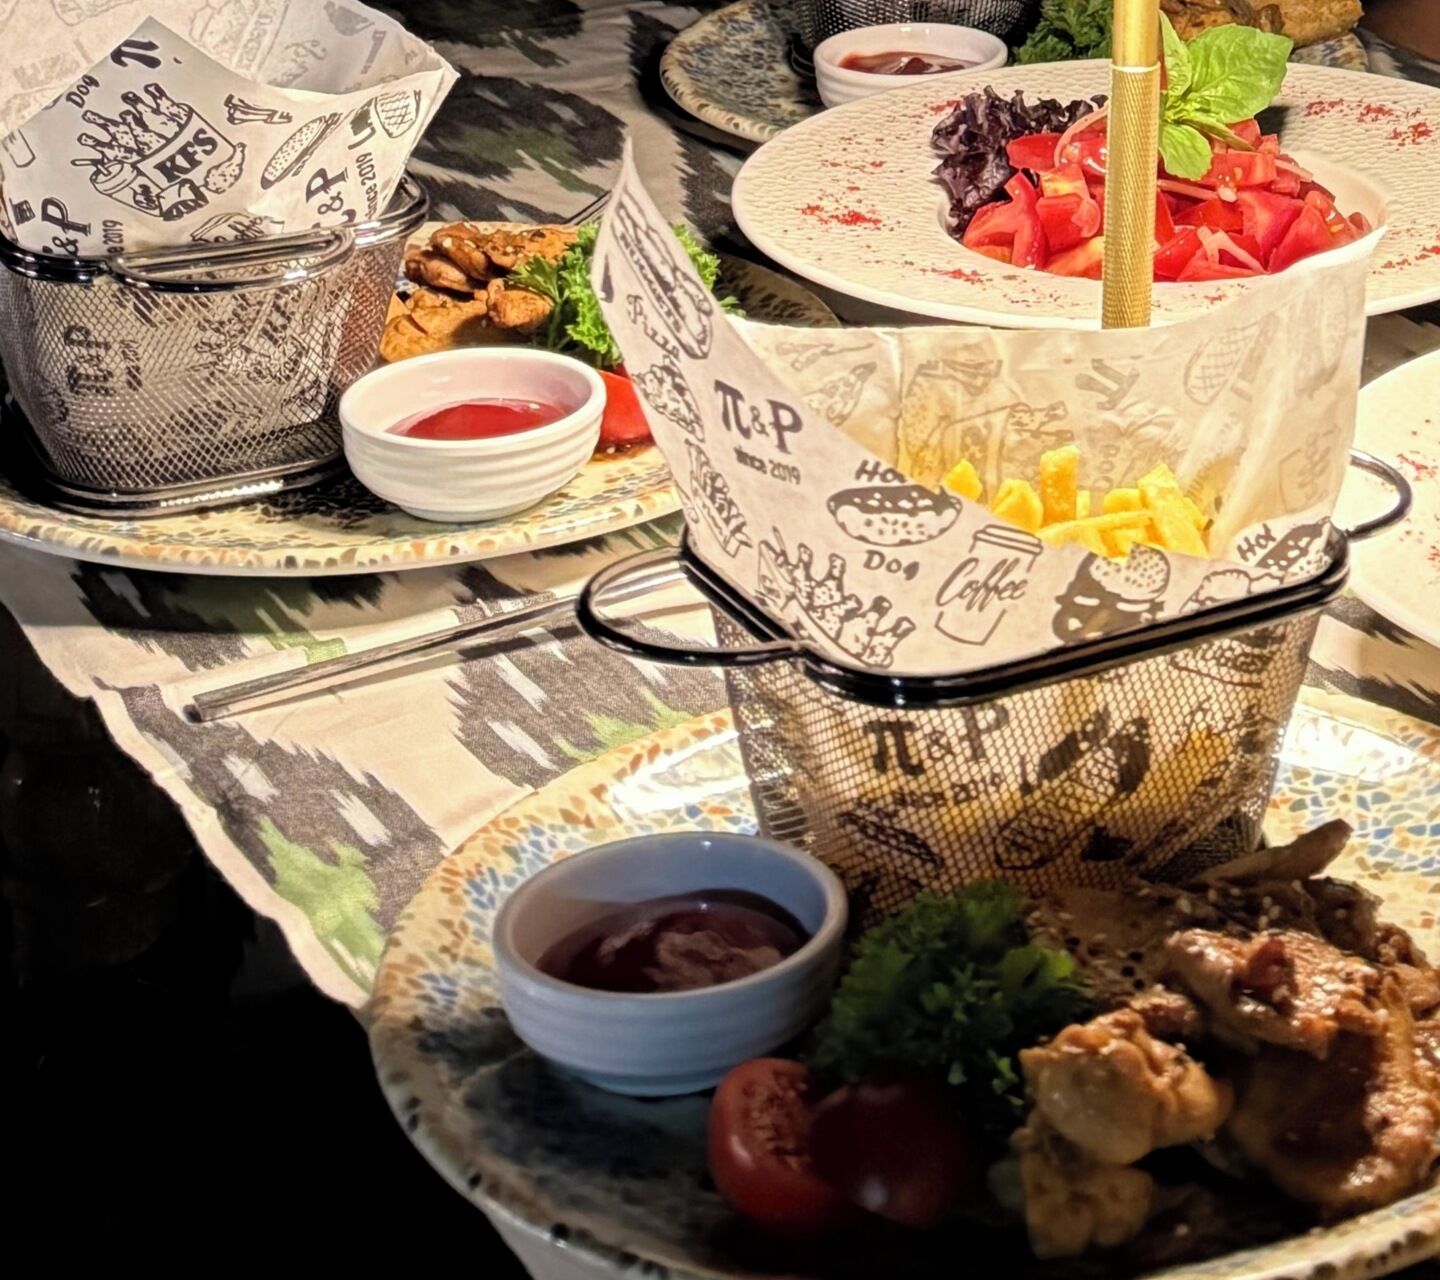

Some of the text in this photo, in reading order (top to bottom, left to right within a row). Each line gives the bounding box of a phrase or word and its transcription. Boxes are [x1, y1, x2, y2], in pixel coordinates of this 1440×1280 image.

[66, 74, 101, 109] Dog
[152, 127, 219, 183] KFS
[355, 152, 377, 186] 2019
[102, 219, 124, 246] 2019
[625, 293, 681, 362] Pizza
[1236, 522, 1278, 562] Hot
[863, 549, 920, 581] Dog
[935, 556, 1029, 613] Coffee
